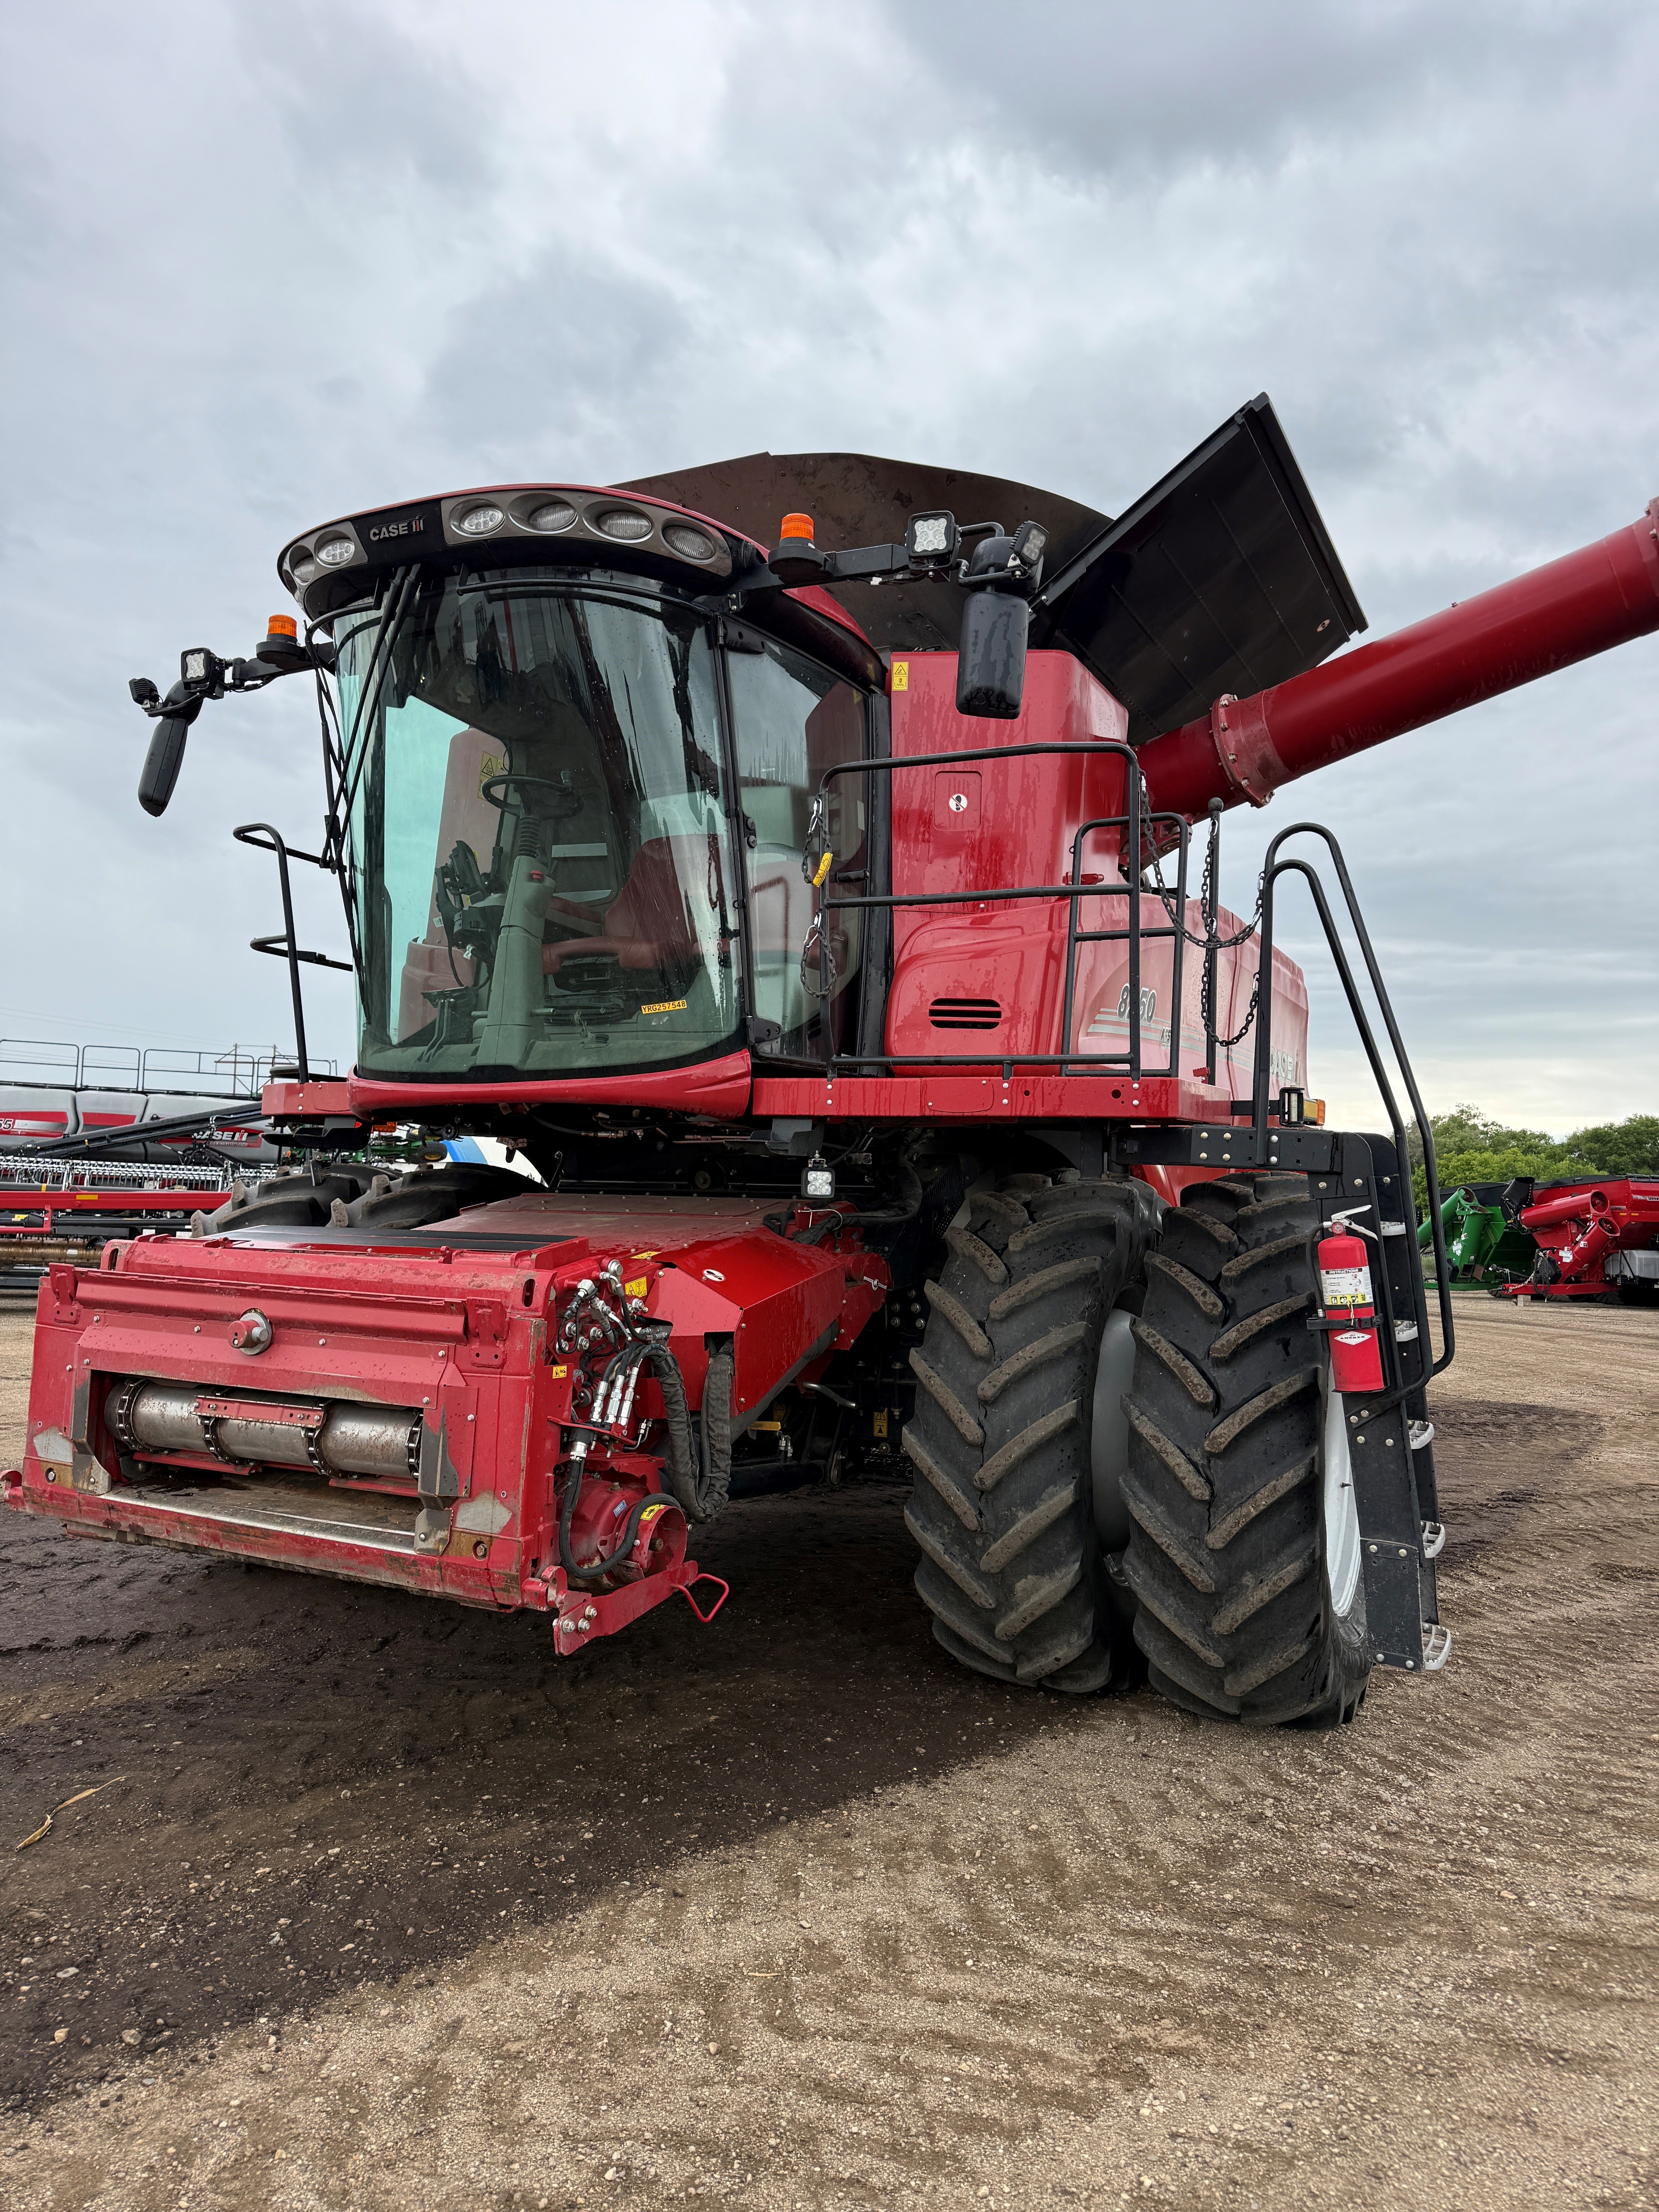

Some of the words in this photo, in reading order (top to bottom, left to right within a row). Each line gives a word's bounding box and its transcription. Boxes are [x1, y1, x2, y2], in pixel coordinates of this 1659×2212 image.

[370, 523, 408, 541] CASE
[642, 1001, 686, 1013] YRG257548
[1117, 983, 1157, 1025] 850
